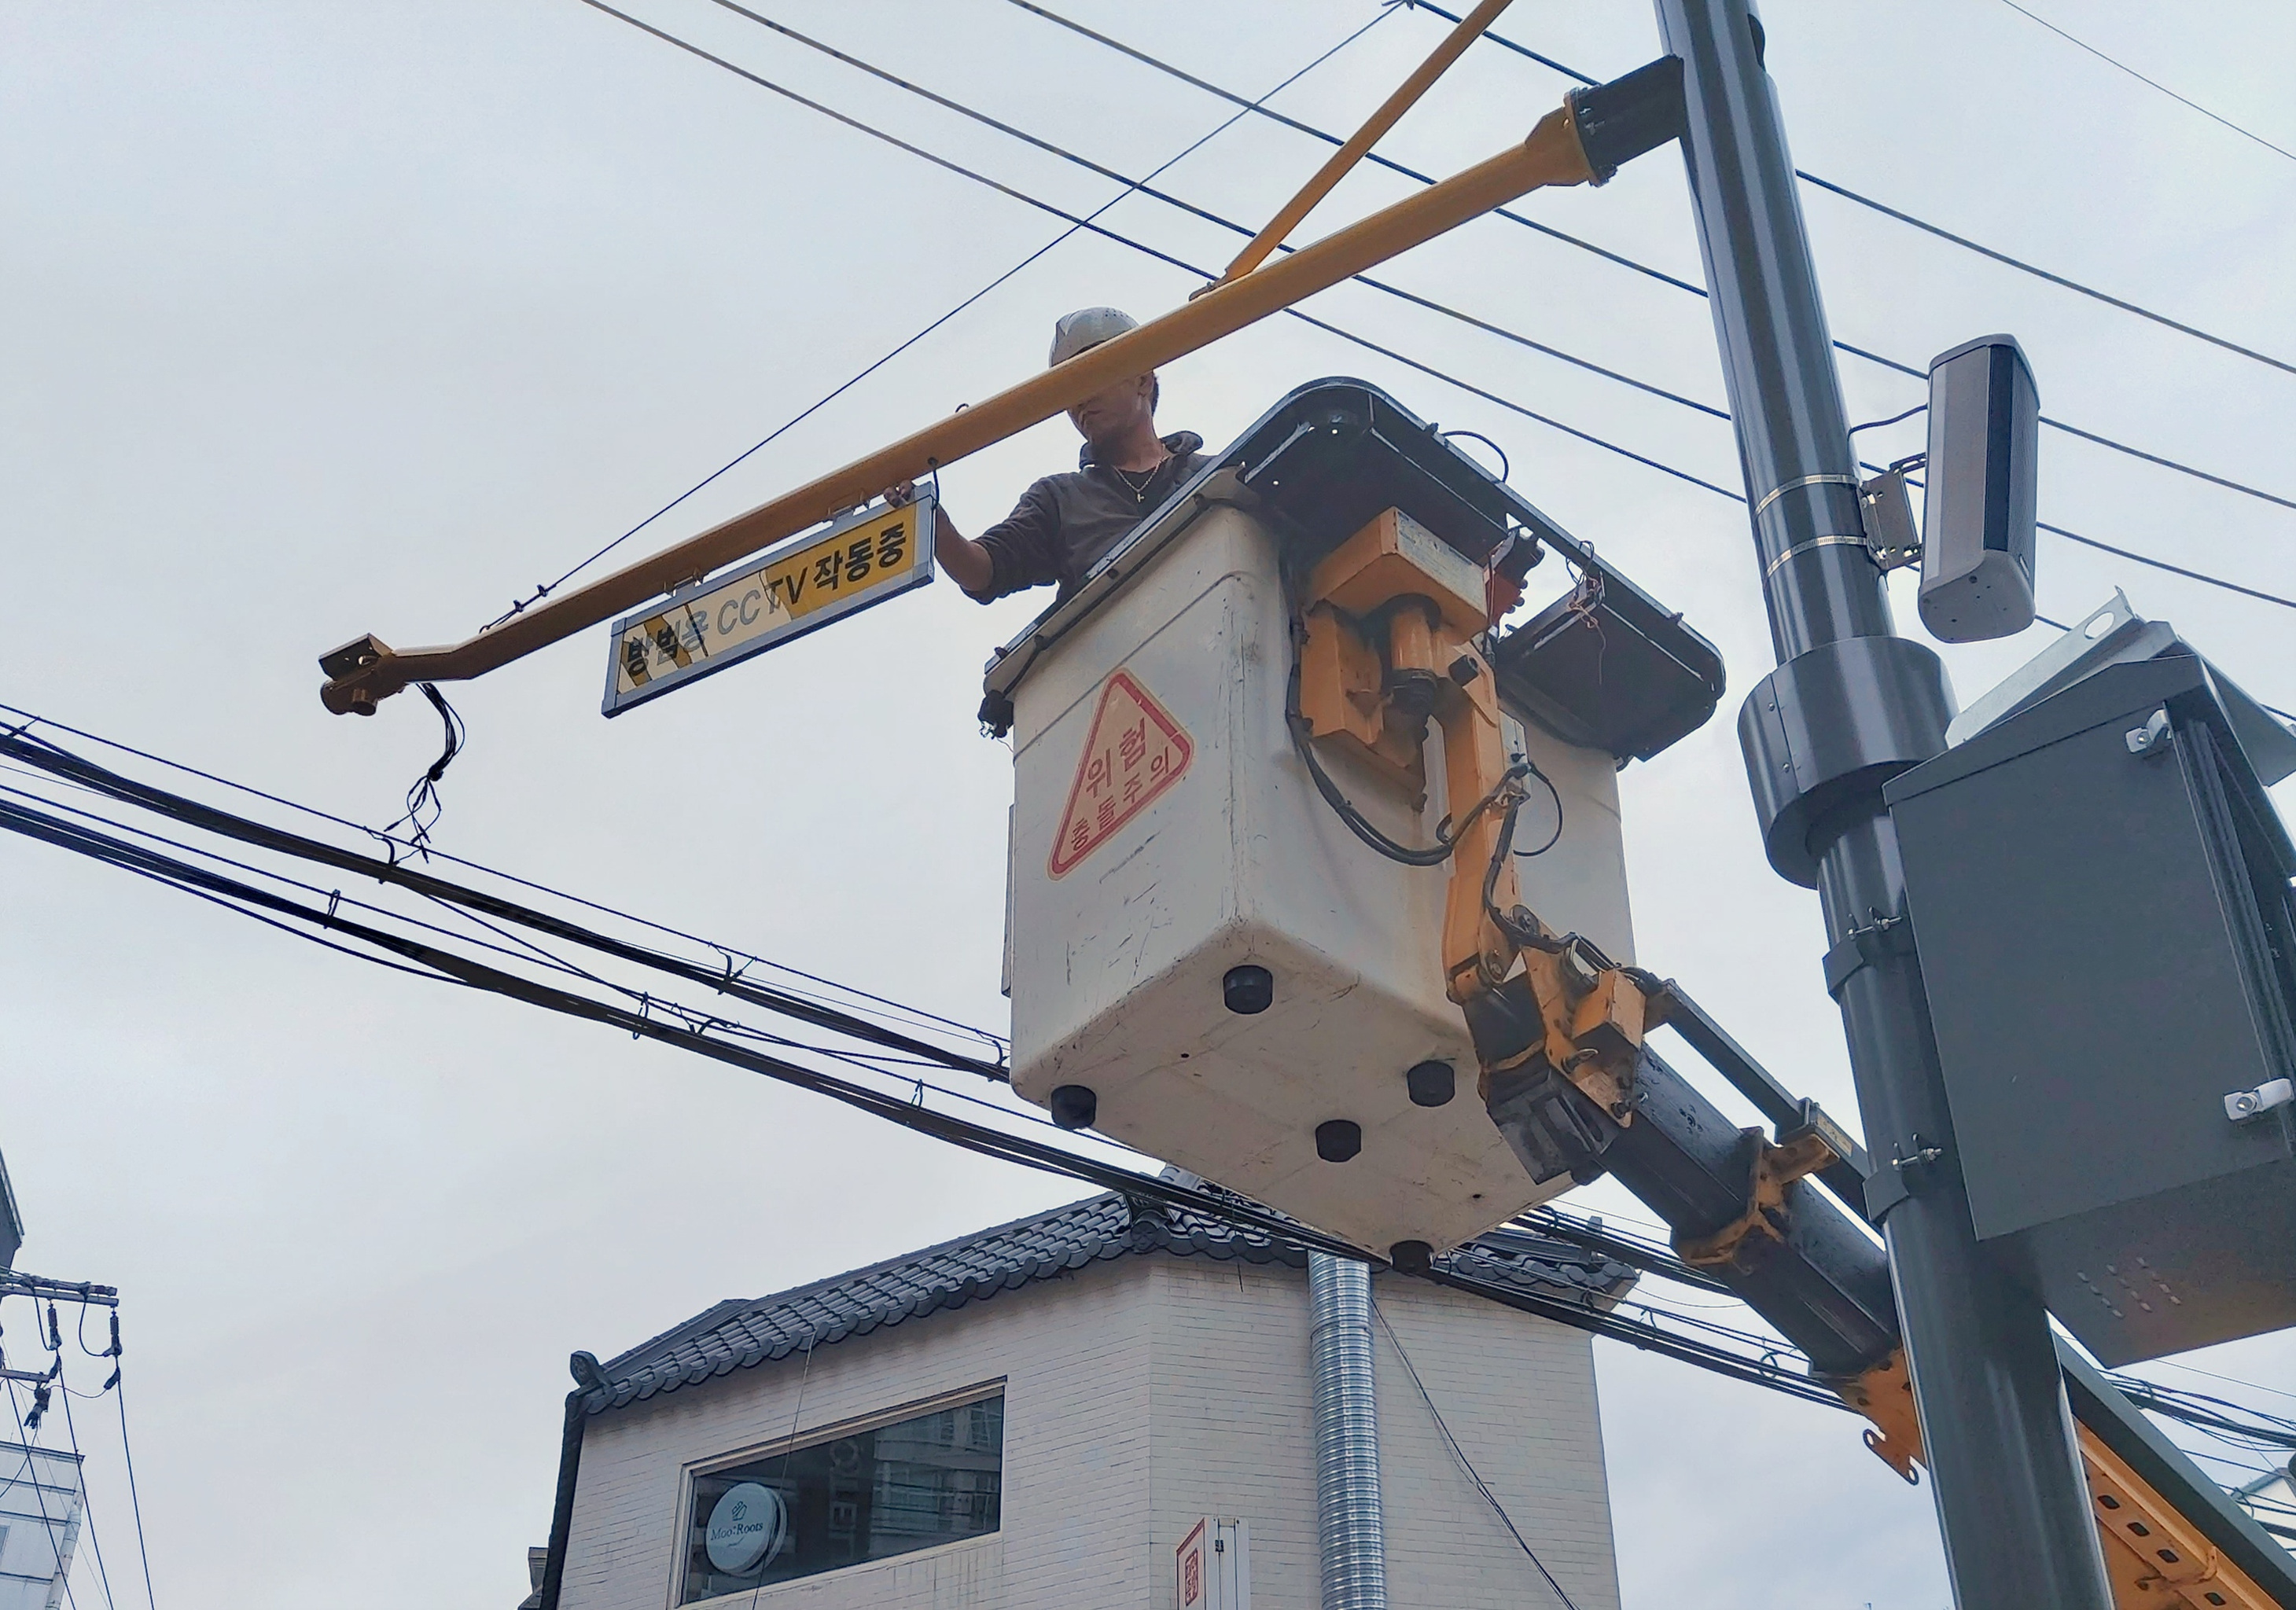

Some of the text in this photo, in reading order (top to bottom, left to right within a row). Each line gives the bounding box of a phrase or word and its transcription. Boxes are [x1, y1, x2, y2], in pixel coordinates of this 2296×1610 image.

[716, 567, 808, 635] CCTV
[813, 522, 907, 591] 작동중
[1086, 717, 1146, 799] 위험
